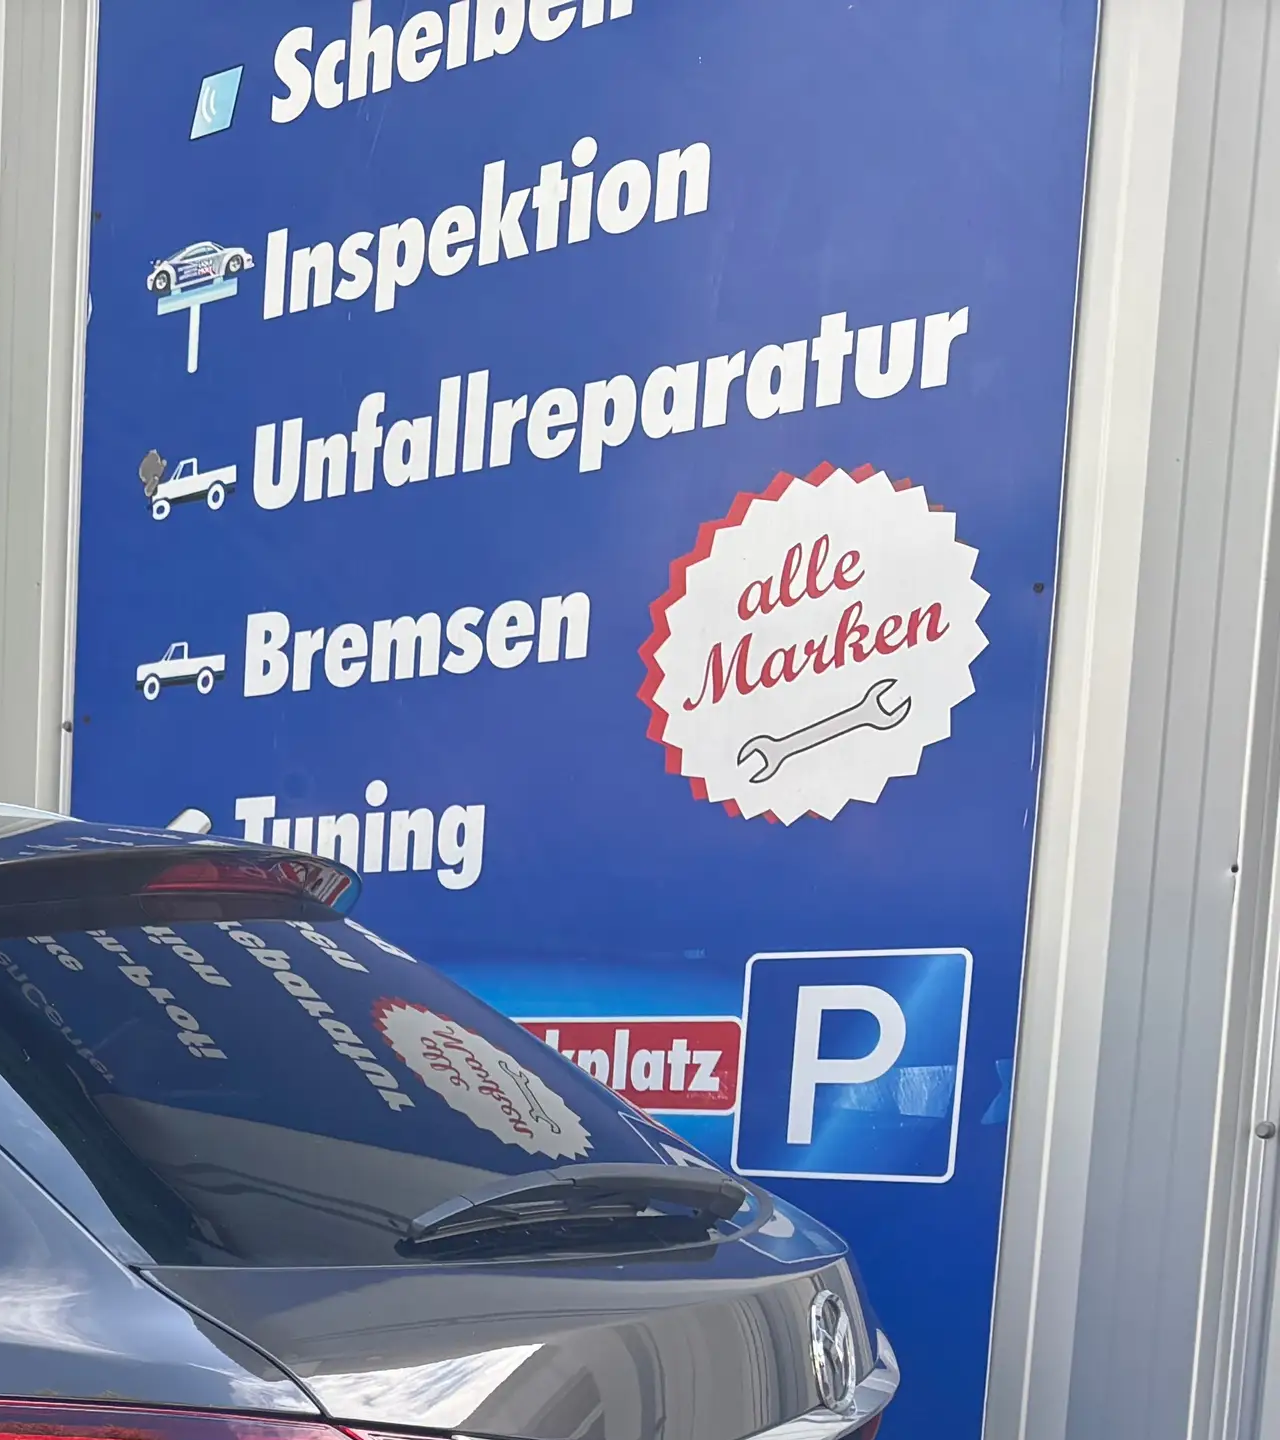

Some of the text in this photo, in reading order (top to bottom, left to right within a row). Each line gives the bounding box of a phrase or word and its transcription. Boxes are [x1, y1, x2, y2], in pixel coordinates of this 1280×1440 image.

[263, 136, 712, 320] Inspektion
[252, 306, 969, 510] Unfallreparatur
[243, 591, 591, 698] Bremsen
[737, 533, 865, 622] alle
[682, 600, 950, 712] Marken
[787, 985, 907, 1145] P
